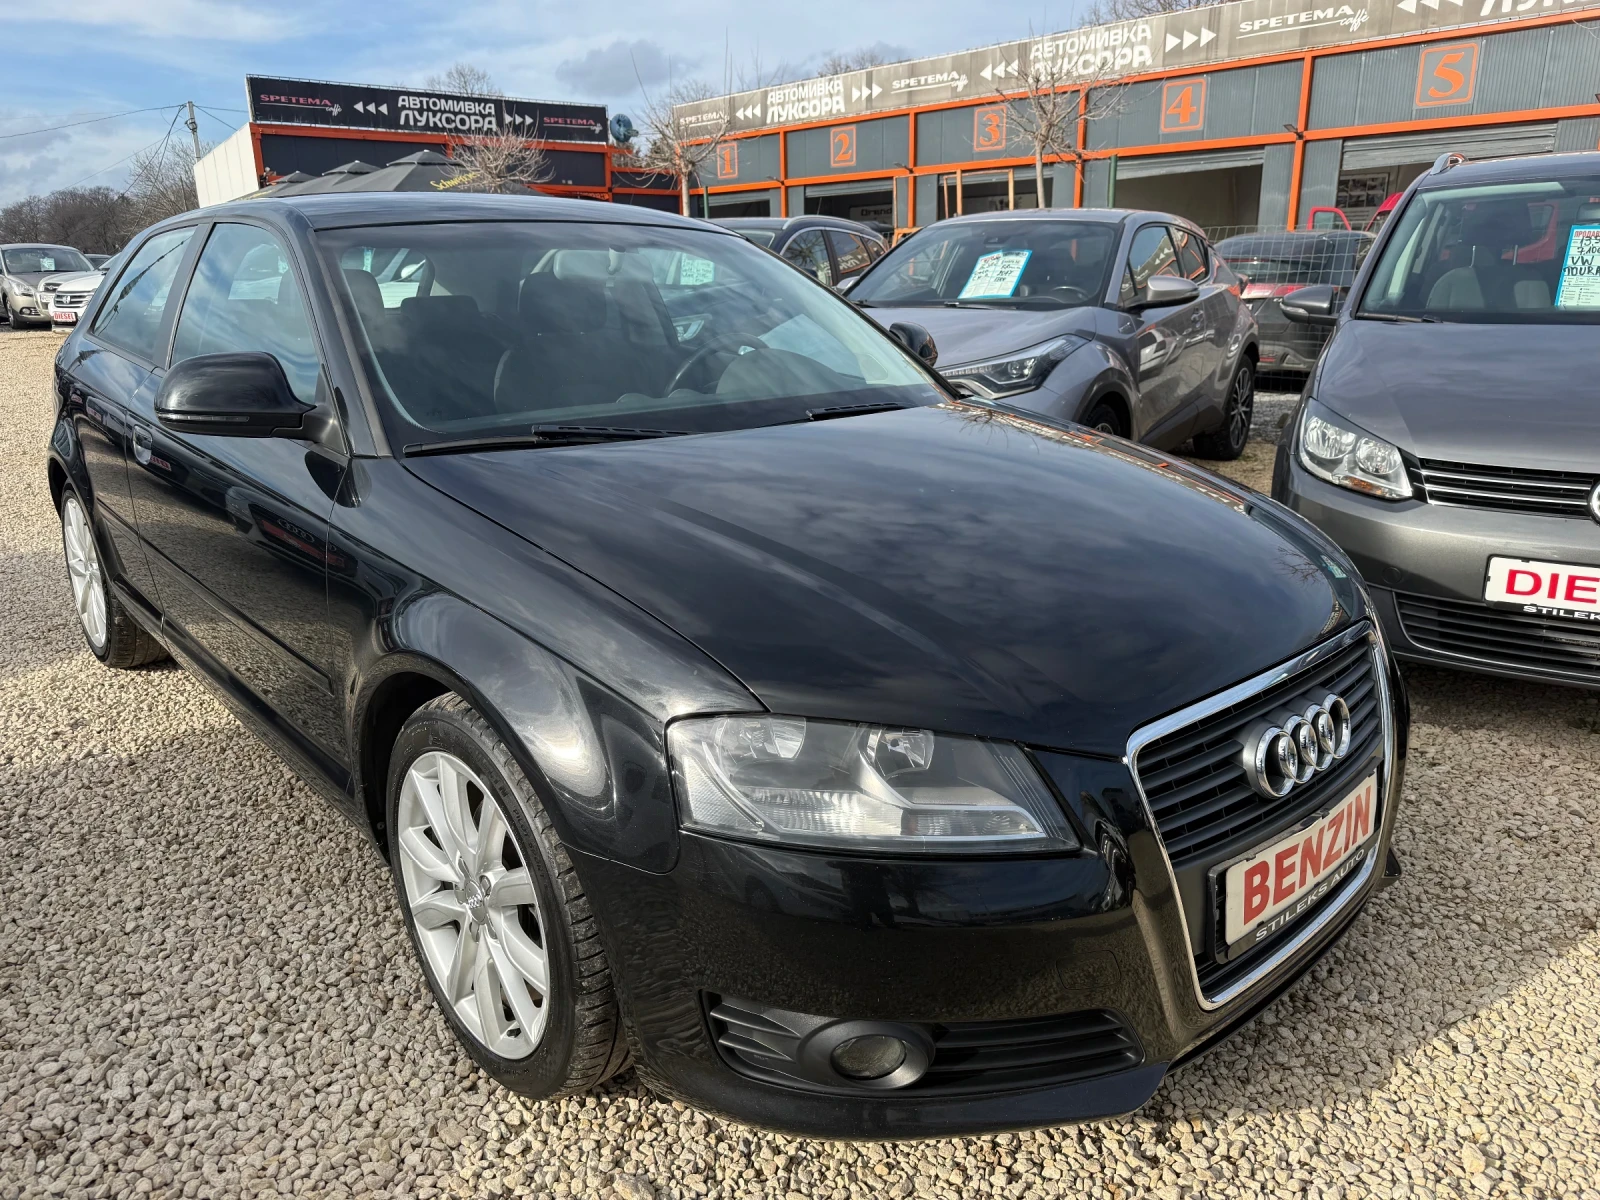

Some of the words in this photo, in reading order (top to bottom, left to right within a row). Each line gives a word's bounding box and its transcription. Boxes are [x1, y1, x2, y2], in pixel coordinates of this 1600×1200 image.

[1239, 5, 1354, 32] SPETEMA
[1029, 24, 1152, 58] АВТОМИВКА
[1028, 45, 1153, 84] ЛУКСОРА
[1428, 52, 1465, 98] 5
[767, 80, 844, 104] АВТОМИВКА
[892, 71, 960, 89] SPETEMA
[260, 94, 332, 106] SPETEMA
[398, 95, 495, 115] АВТОМИВКА
[766, 95, 845, 124] ЛУКСОРА
[1167, 86, 1196, 124] 4
[400, 110, 497, 132] ЛУКСОРА
[543, 117, 595, 126] SPETEMA
[979, 113, 1000, 146] 3
[835, 133, 852, 161] 2
[722, 148, 733, 174] 1
[1571, 255, 1595, 266] VW
[54, 312, 75, 320] DIESEL
[1505, 568, 1600, 604] DIE
[1244, 785, 1372, 926] BENZIN
[1255, 883, 1328, 942] STILEKS
[1331, 849, 1365, 887] AUTO
